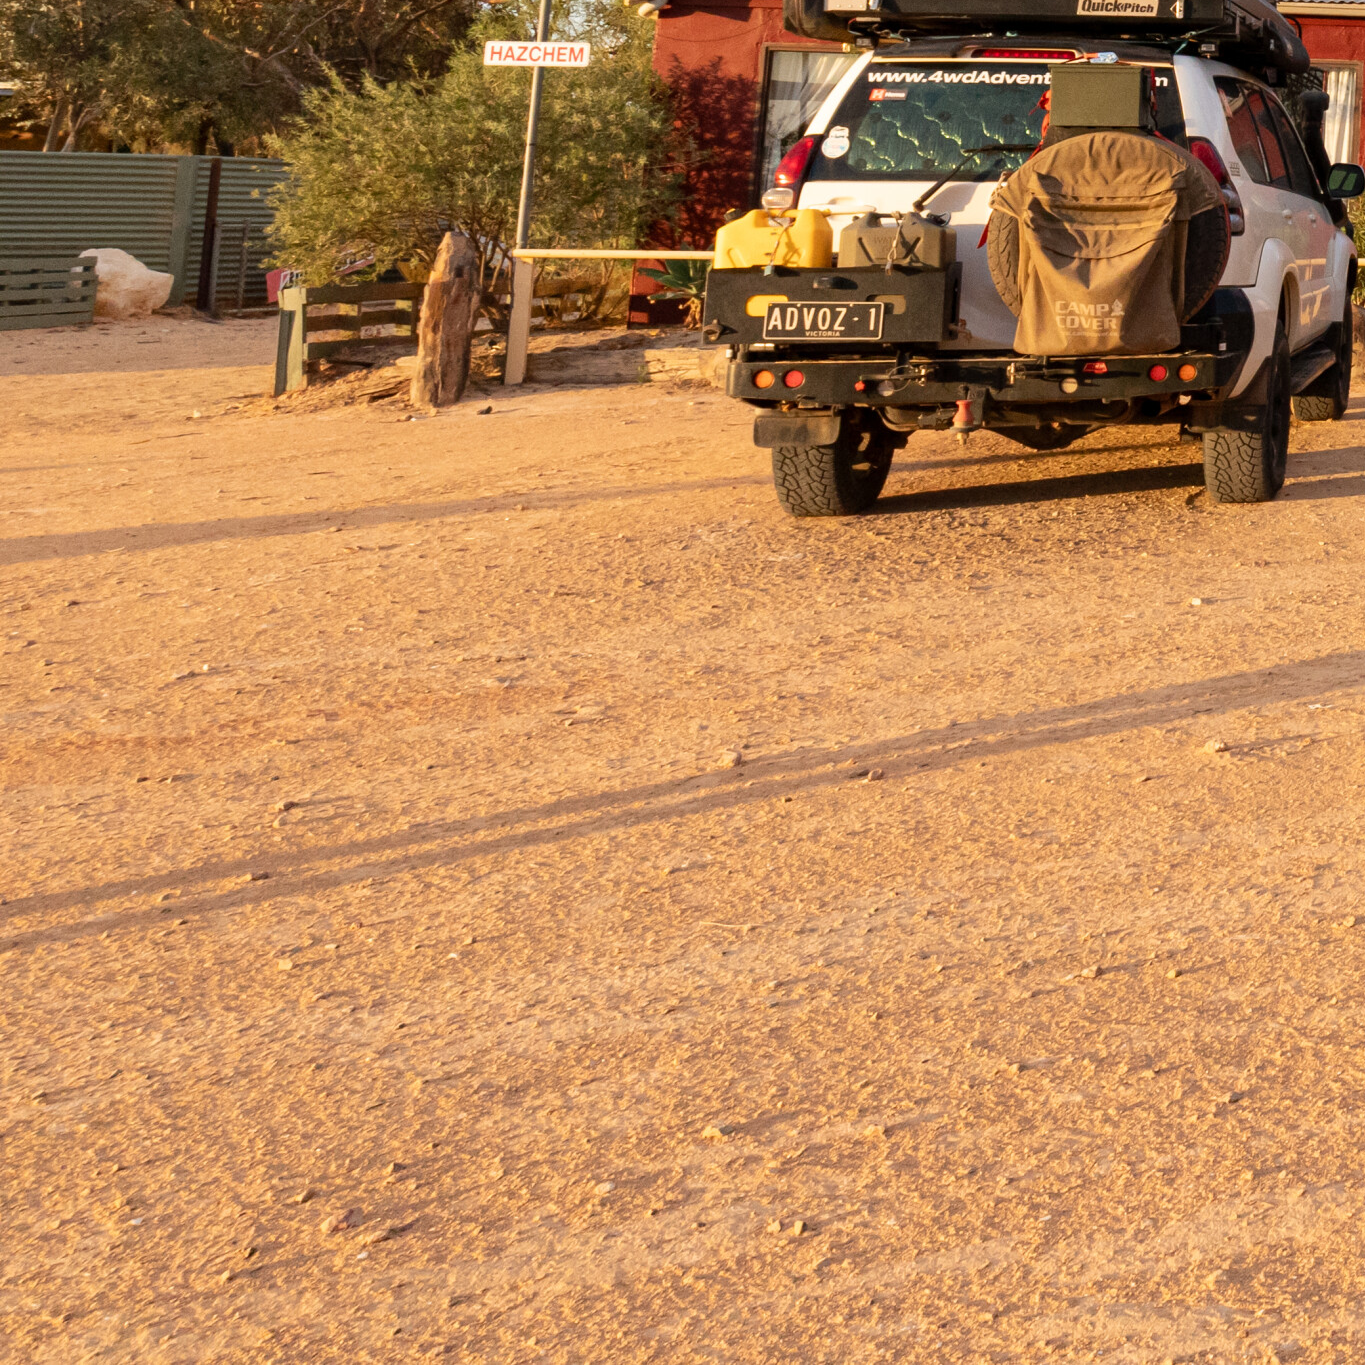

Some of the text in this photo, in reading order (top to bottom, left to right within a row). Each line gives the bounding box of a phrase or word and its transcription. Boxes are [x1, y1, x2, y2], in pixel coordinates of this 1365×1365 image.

[490, 46, 585, 62] HAZCHEM
[1055, 300, 1109, 316] CAMP
[1055, 315, 1117, 330] COVER
